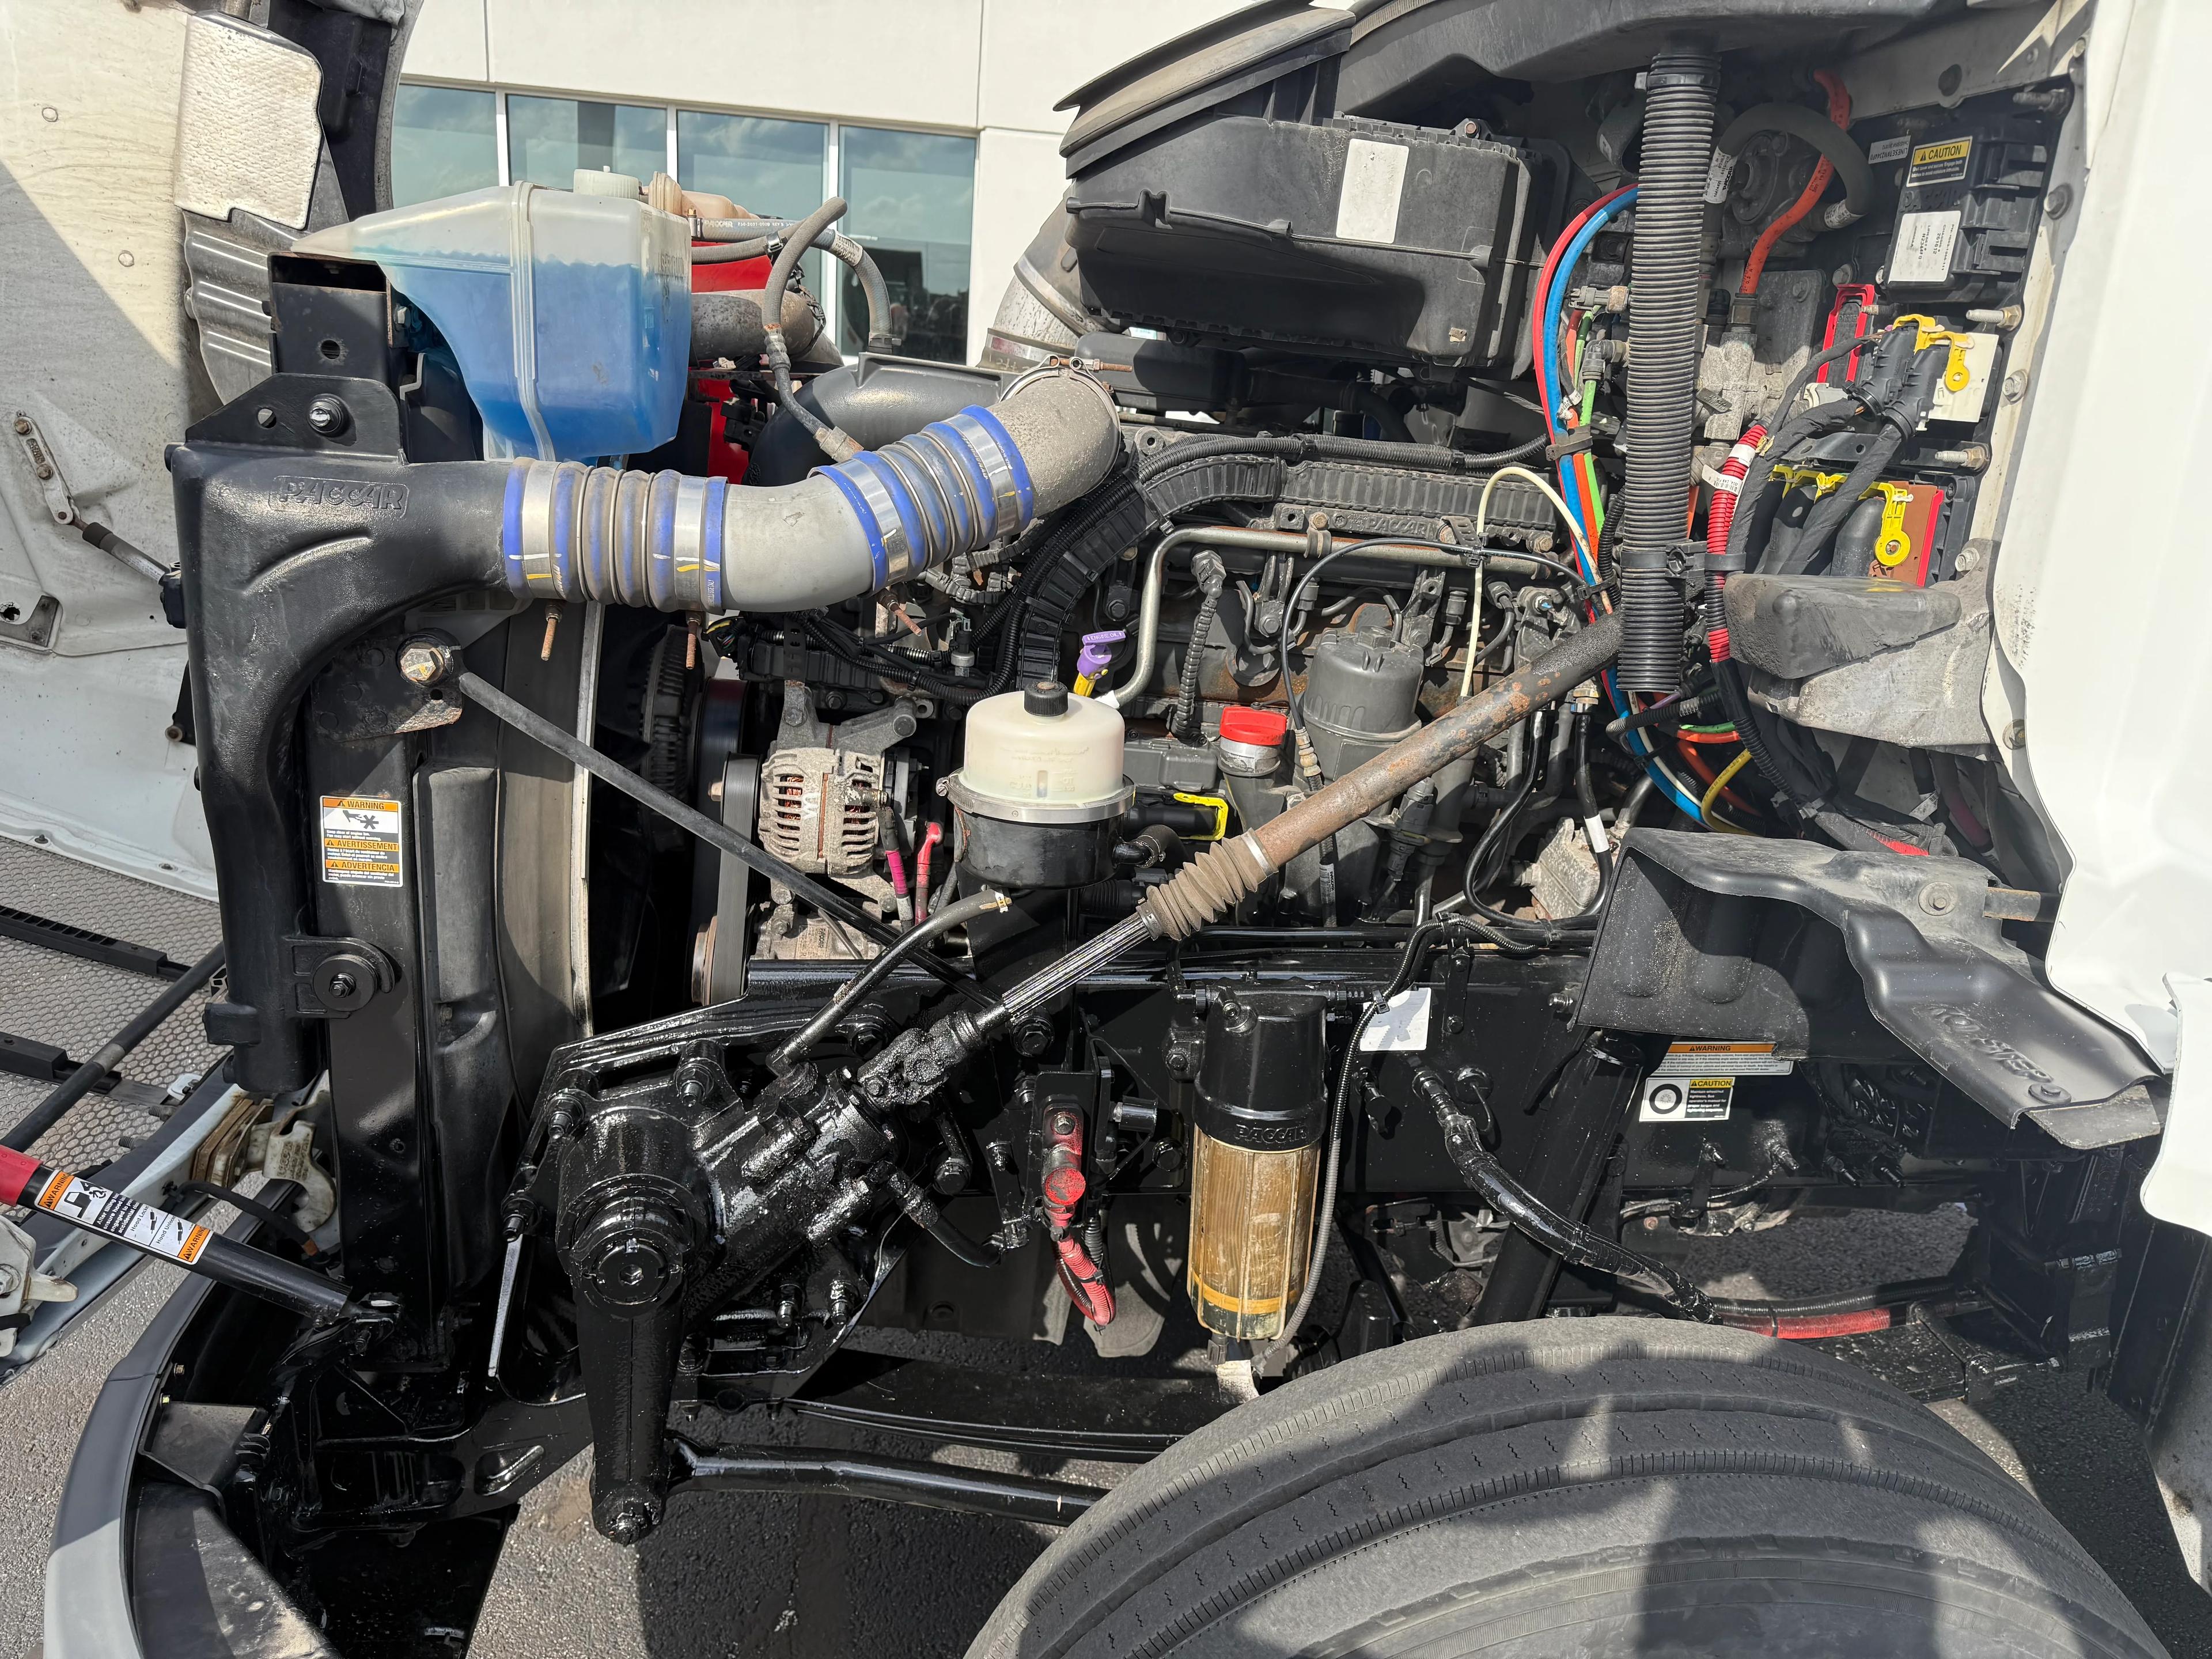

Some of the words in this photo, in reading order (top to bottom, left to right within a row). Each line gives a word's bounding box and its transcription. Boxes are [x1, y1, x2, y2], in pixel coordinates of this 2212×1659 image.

[1929, 145, 1962, 160] CAUTION
[279, 480, 403, 510] PACCAR
[1365, 518, 1427, 536] PACCAR
[347, 801, 384, 810] WARNING
[337, 840, 397, 850] AVERTISSEMENT
[342, 861, 395, 872] ADVERTENCIA
[1974, 1036, 2053, 1084] STEP
[1234, 1124, 1307, 1143] PACCAR
[96, 1213, 107, 1225] After
[105, 1199, 116, 1214] tilting
[103, 1212, 116, 1230] ensure
[114, 1202, 123, 1213] hood
[111, 1210, 125, 1232] engaged
[118, 1209, 135, 1234] accidental
[130, 1218, 139, 1232] Hood
[156, 1230, 166, 1244] Hood
